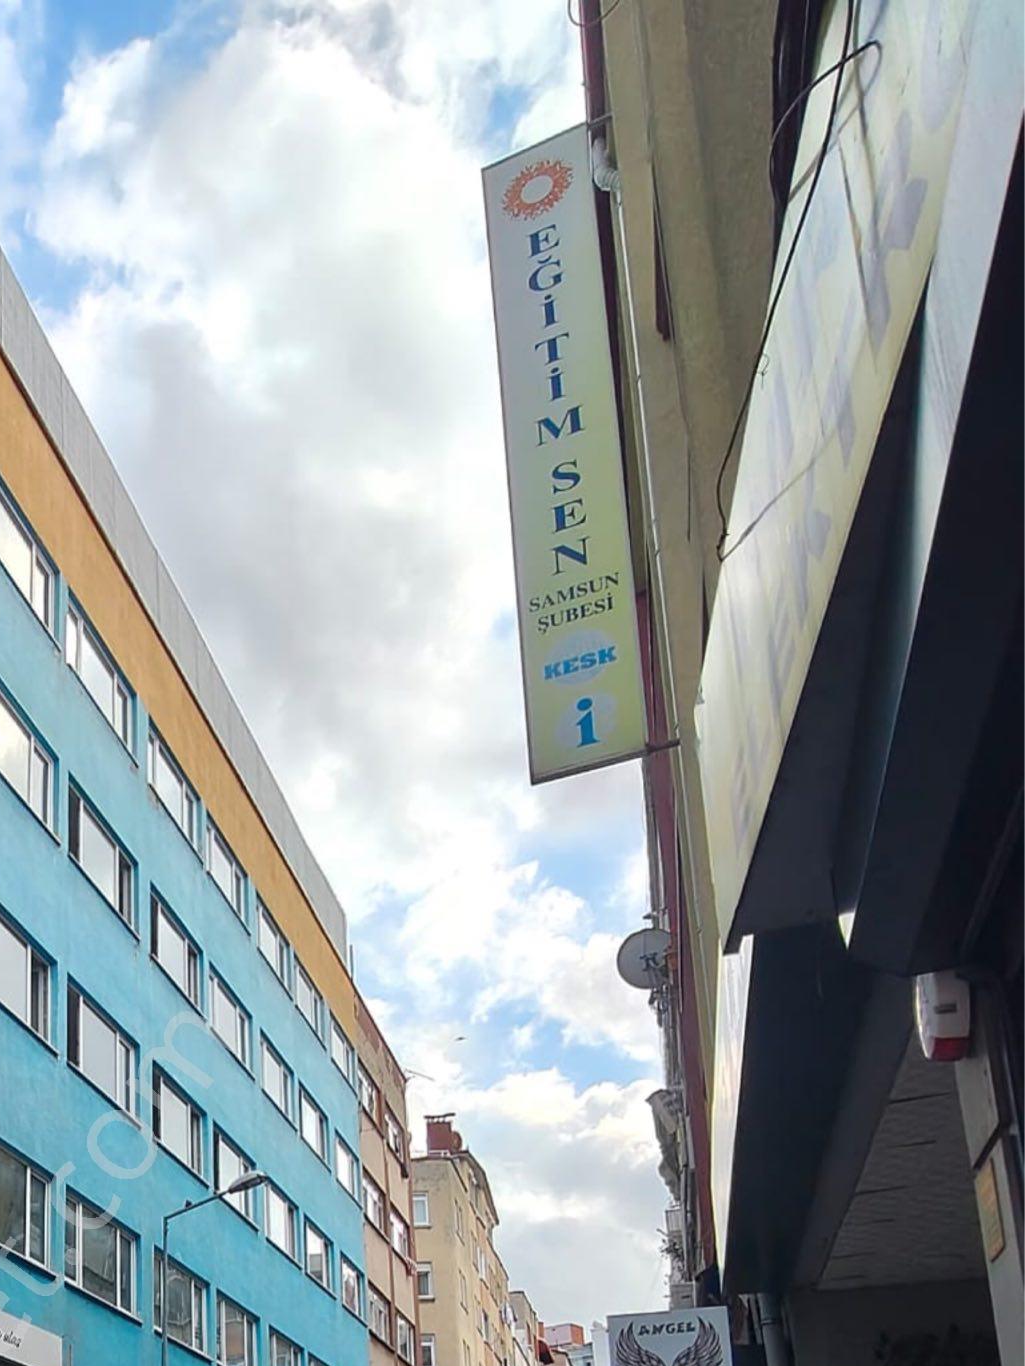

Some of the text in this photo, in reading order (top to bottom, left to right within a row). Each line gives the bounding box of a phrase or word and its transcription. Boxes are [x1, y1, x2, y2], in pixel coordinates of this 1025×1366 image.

[525, 224, 591, 576] EĞİTİM SEN
[528, 572, 620, 613] SAMSUN
[537, 592, 615, 635] ŞUBESİ
[543, 645, 618, 681] KESK
[638, 1320, 696, 1336] ANGEL
